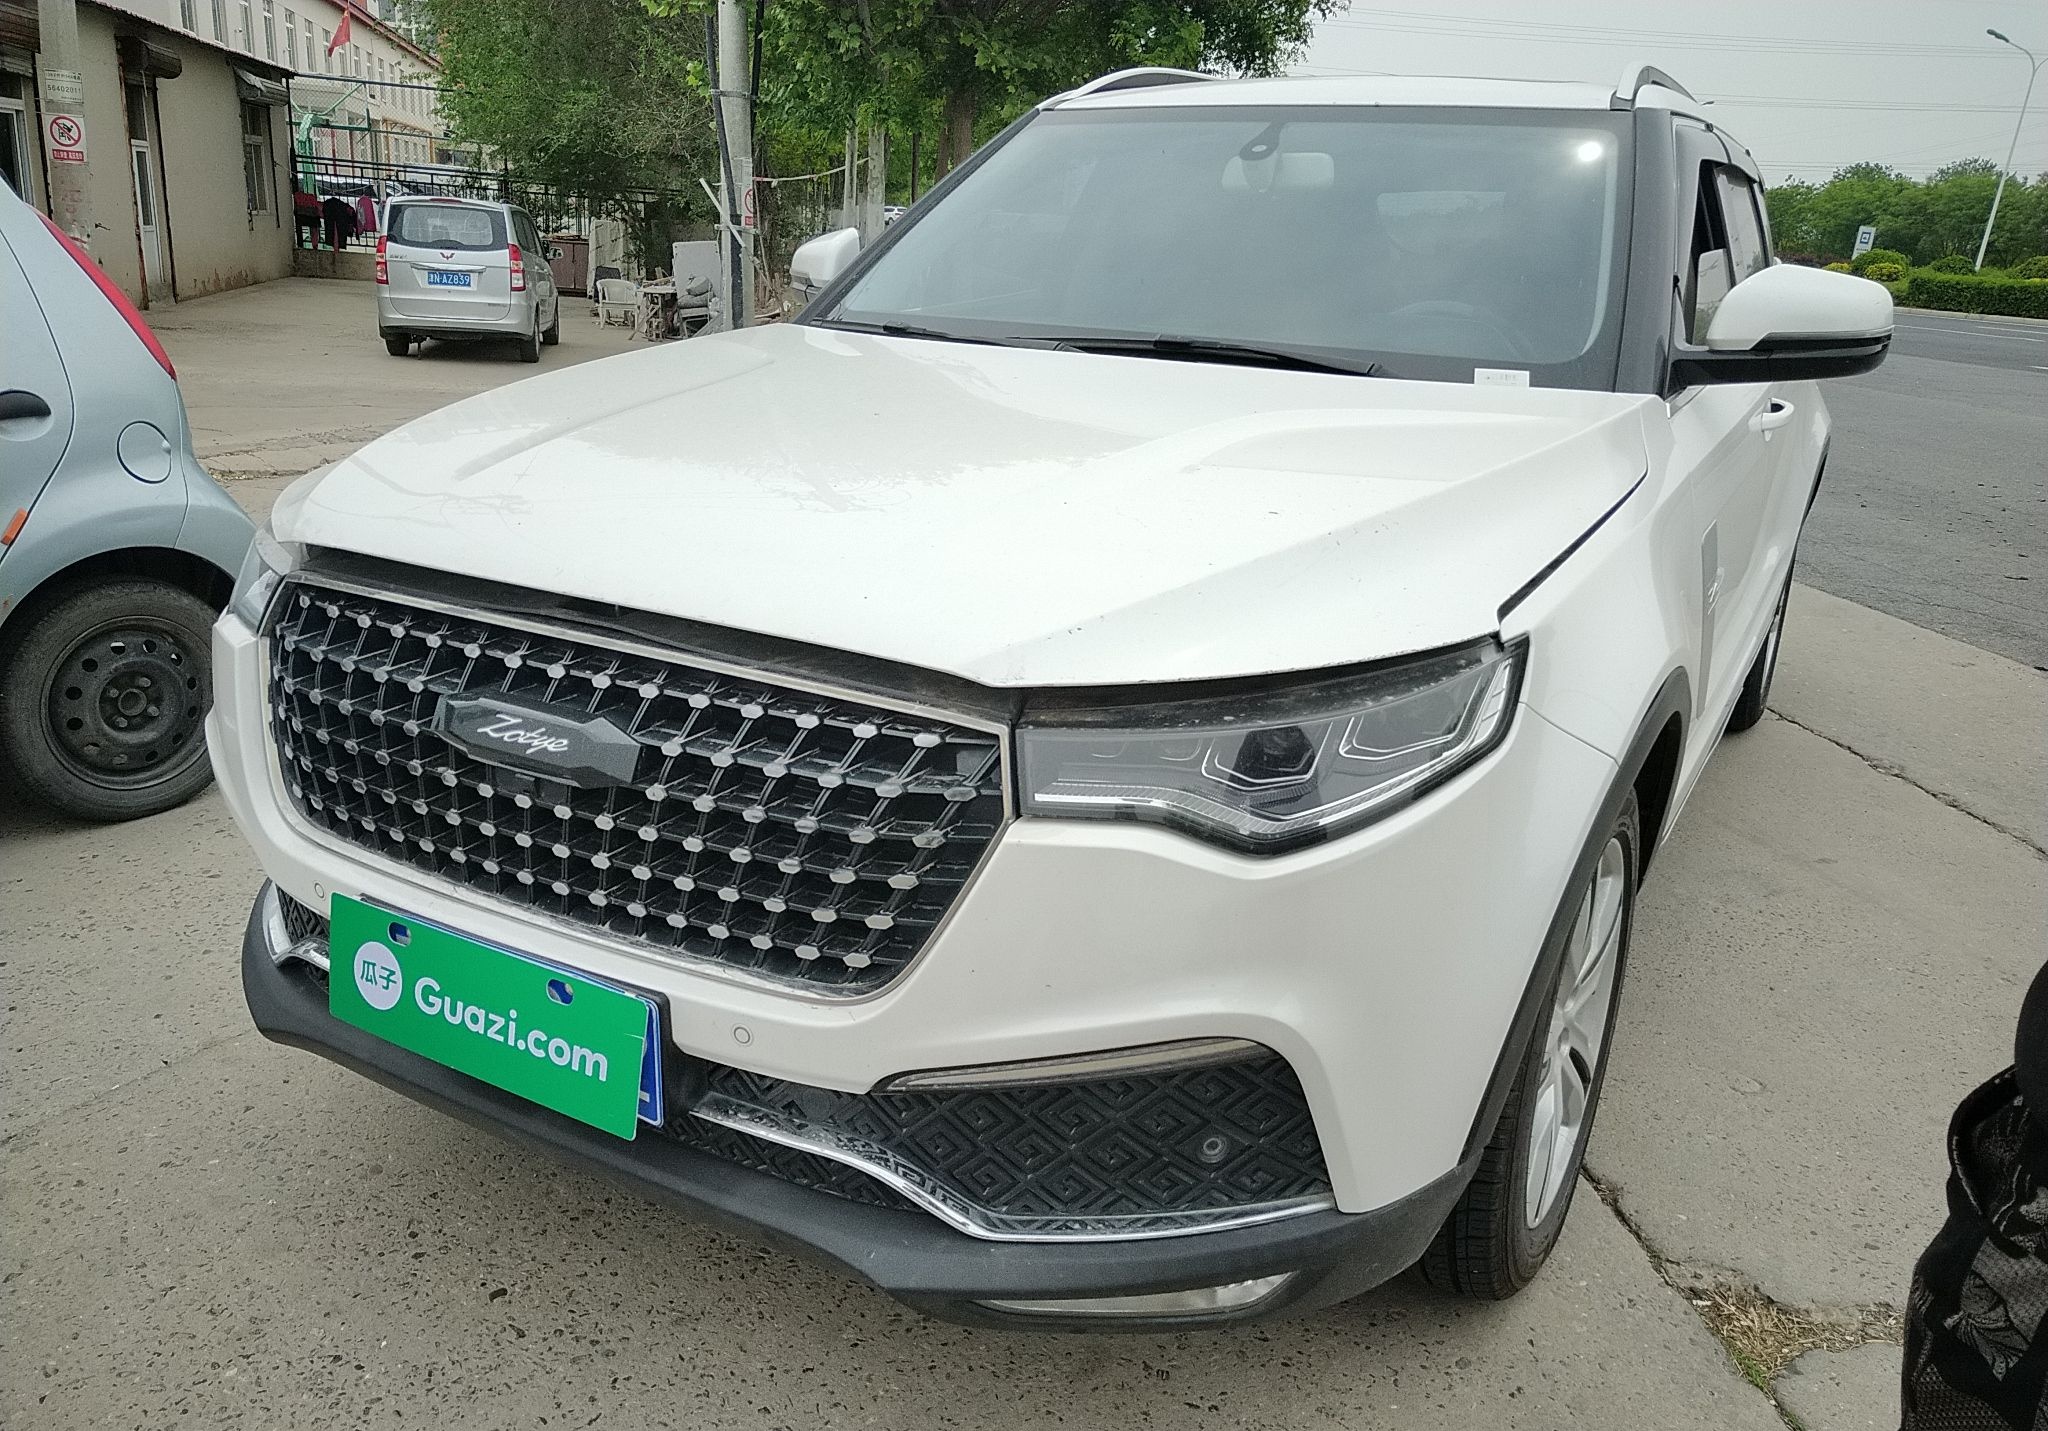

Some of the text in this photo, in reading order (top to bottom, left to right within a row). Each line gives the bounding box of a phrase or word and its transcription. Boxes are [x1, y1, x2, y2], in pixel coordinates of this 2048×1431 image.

[476, 713, 568, 755] Zotye
[360, 959, 397, 991] 瓜子
[414, 976, 608, 1082] Guazi.com
